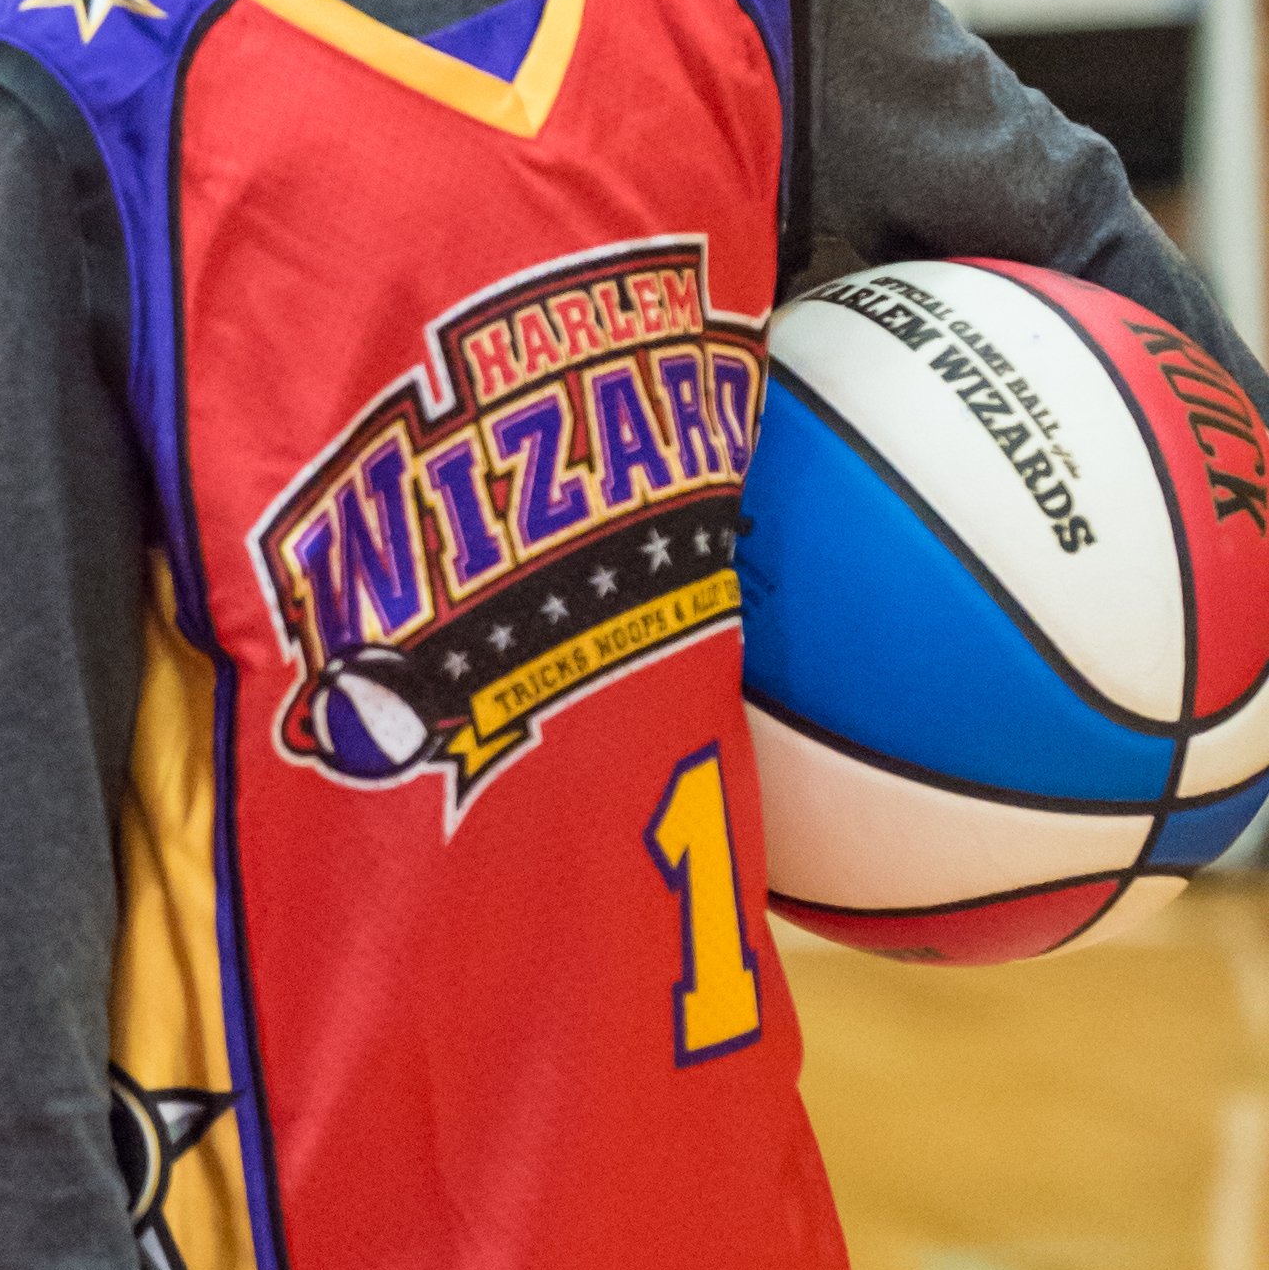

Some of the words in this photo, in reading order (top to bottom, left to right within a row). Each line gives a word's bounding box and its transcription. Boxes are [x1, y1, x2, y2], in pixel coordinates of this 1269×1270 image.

[463, 269, 702, 404] HARLEM
[948, 320, 1016, 377] GAME
[1005, 377, 1061, 440] BALL
[929, 344, 1098, 555] WIZARDS
[494, 646, 590, 714] TRICKS
[643, 739, 763, 1069] 1
